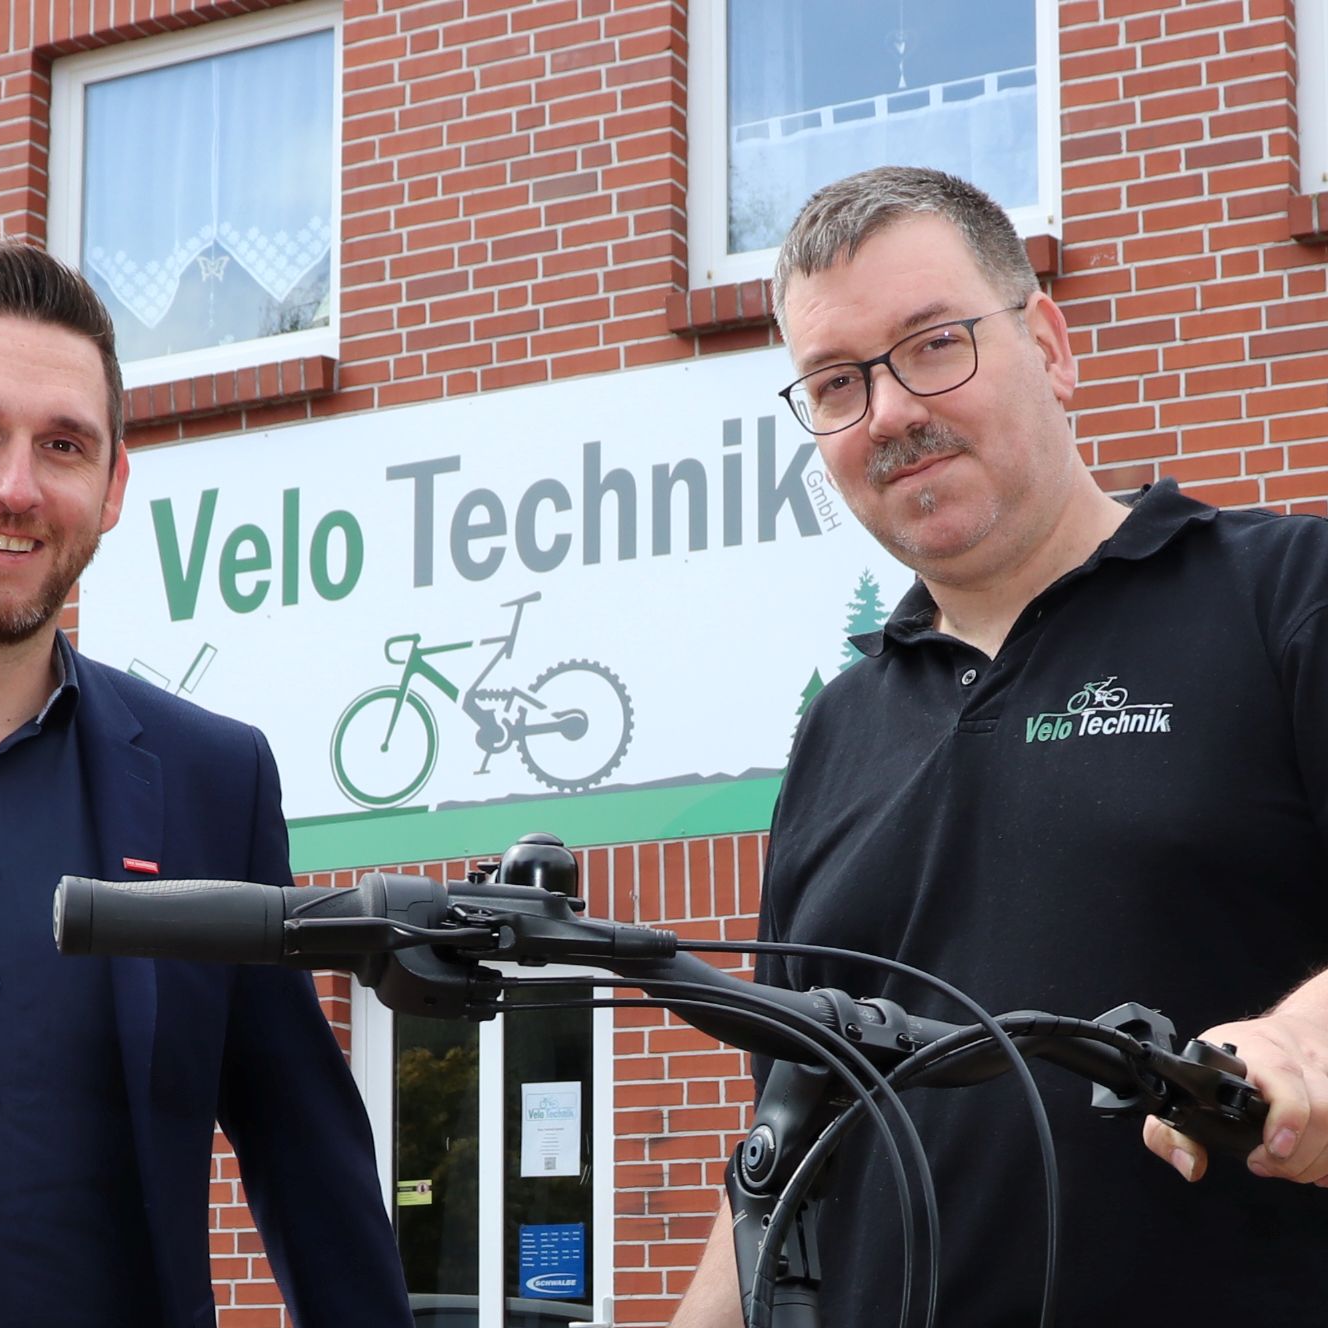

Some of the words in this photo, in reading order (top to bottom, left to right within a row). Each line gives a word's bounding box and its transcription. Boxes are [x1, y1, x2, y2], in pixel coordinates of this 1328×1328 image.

[806, 470, 842, 532] GmbH
[150, 487, 365, 623] Velo
[385, 414, 822, 590] Technik
[1025, 714, 1073, 743] Velo
[1078, 709, 1170, 736] Technik
[528, 1109, 545, 1119] Velo
[535, 1279, 577, 1287] SCHWALBE
